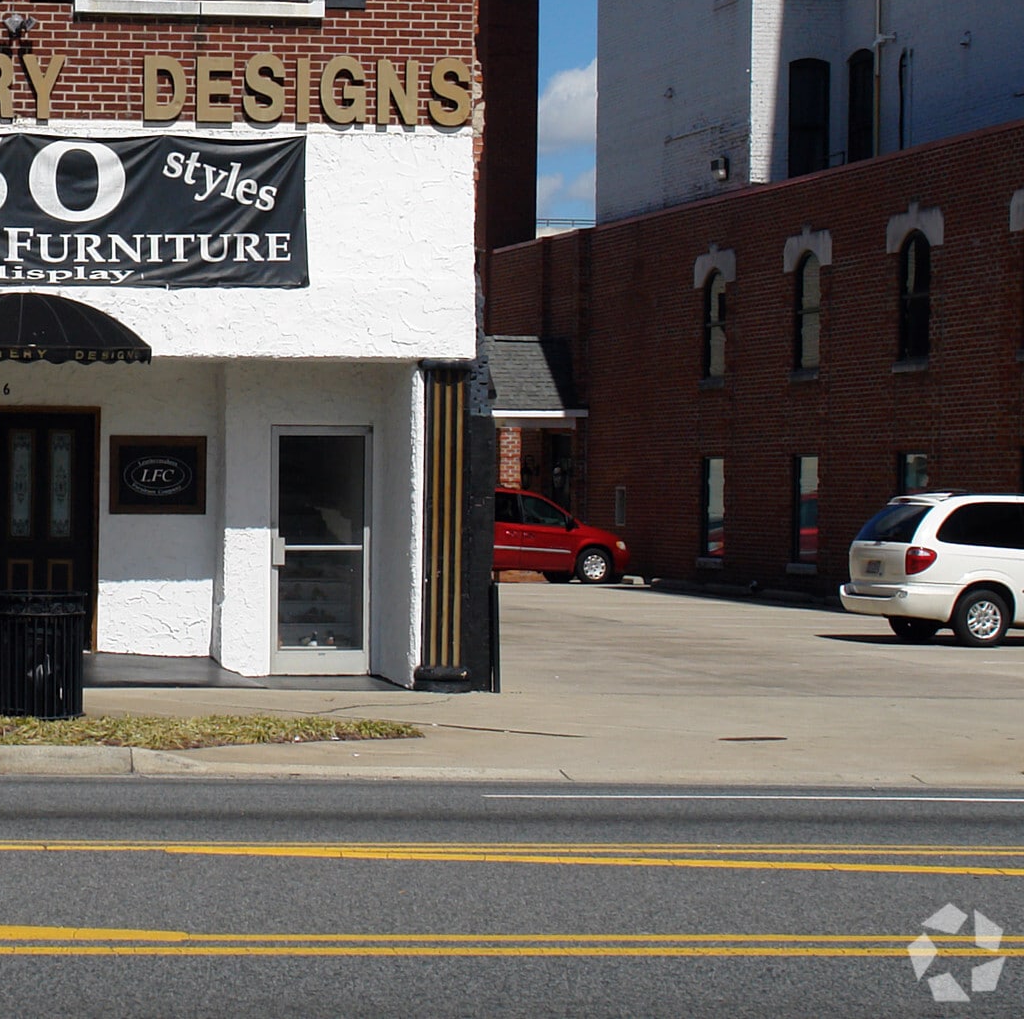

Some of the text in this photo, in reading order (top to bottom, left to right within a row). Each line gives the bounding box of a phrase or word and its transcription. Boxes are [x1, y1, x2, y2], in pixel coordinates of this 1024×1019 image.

[143, 52, 471, 126] DESIGNS
[162, 151, 278, 212] styles
[3, 226, 292, 263] FURNITURE
[141, 468, 175, 483] LFC
